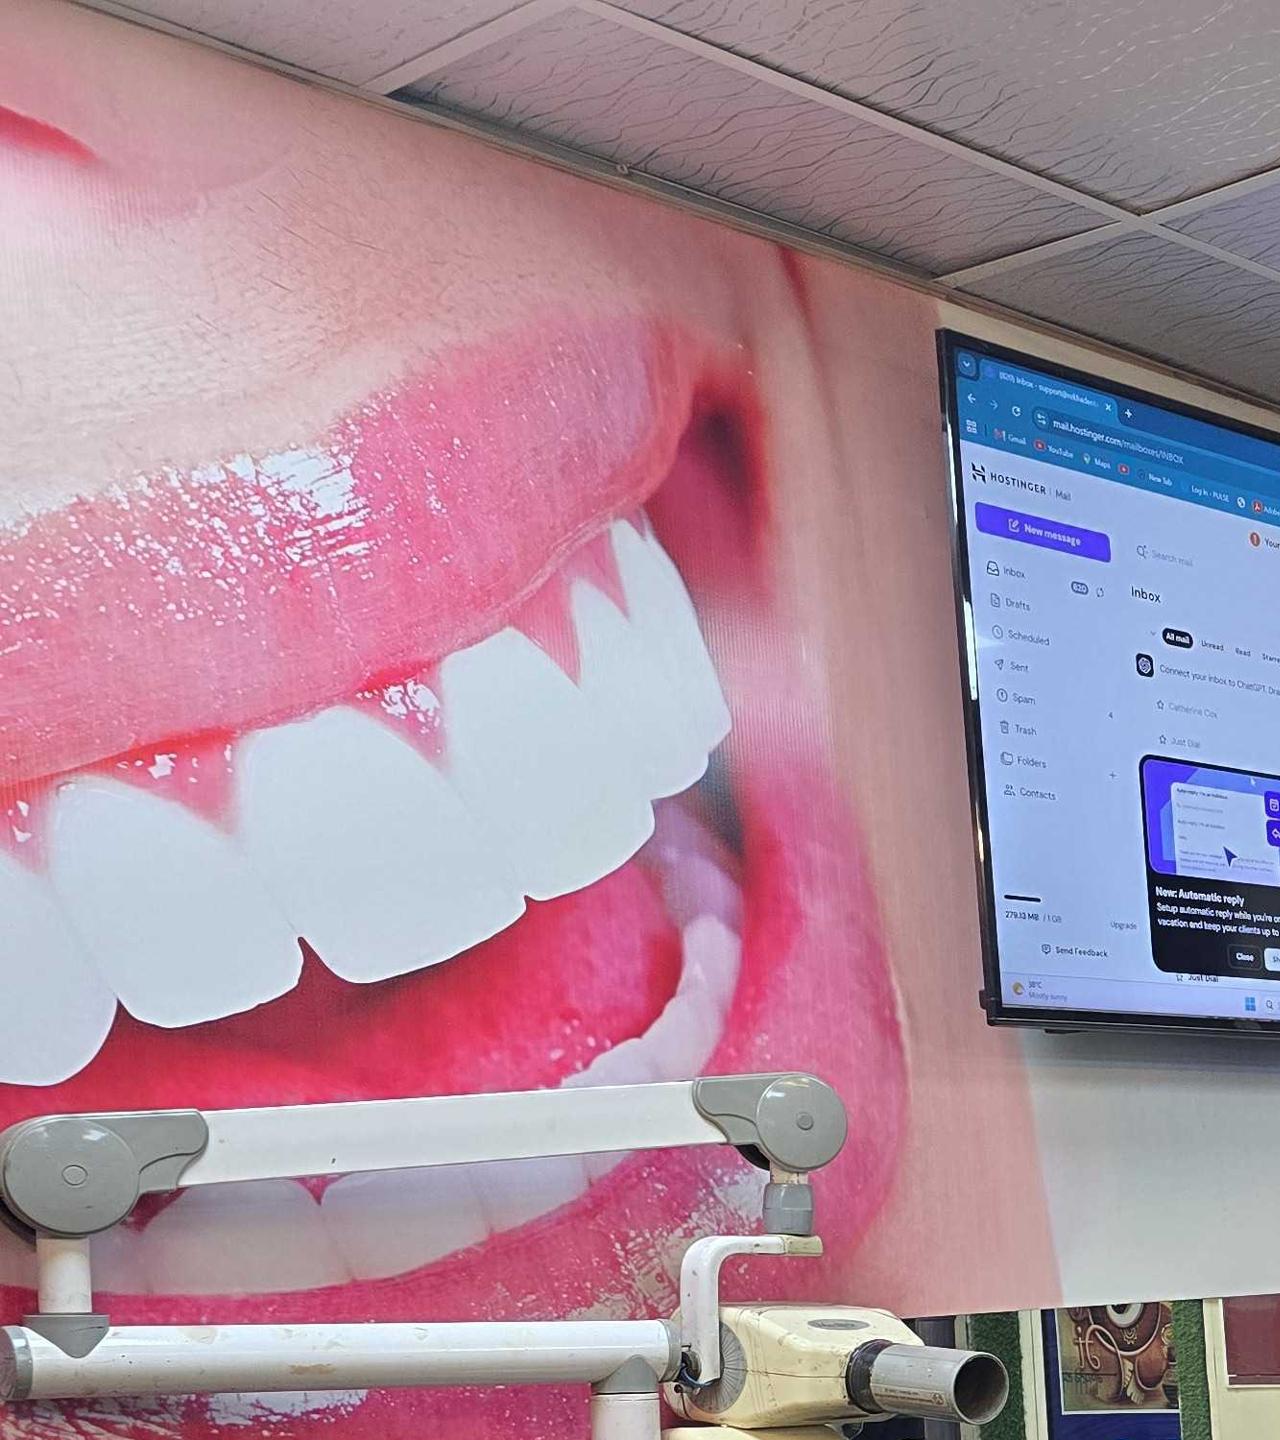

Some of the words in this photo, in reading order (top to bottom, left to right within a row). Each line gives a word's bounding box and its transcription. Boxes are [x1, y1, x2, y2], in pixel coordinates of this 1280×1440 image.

[990, 472, 1046, 495] HOSTINGER
[1055, 488, 1072, 501] Mail
[1024, 522, 1042, 537] New
[1042, 528, 1082, 548] message
[1003, 566, 1026, 580] Inbox
[1131, 586, 1162, 604] Inbox
[1005, 598, 1031, 612] Drafts
[1007, 629, 1051, 647] Scheduled
[1010, 660, 1029, 674] Sent
[1012, 692, 1036, 706] Spam
[1014, 724, 1037, 736] Trash
[1017, 755, 1047, 770] Folders
[1019, 786, 1056, 801] Contacts
[1178, 888, 1222, 903] Automatic
[1223, 895, 1245, 907] reply
[1156, 902, 1178, 914] Setup
[1179, 906, 1215, 917] automatic
[1215, 909, 1234, 921] reply
[1157, 917, 1188, 928] vacation
